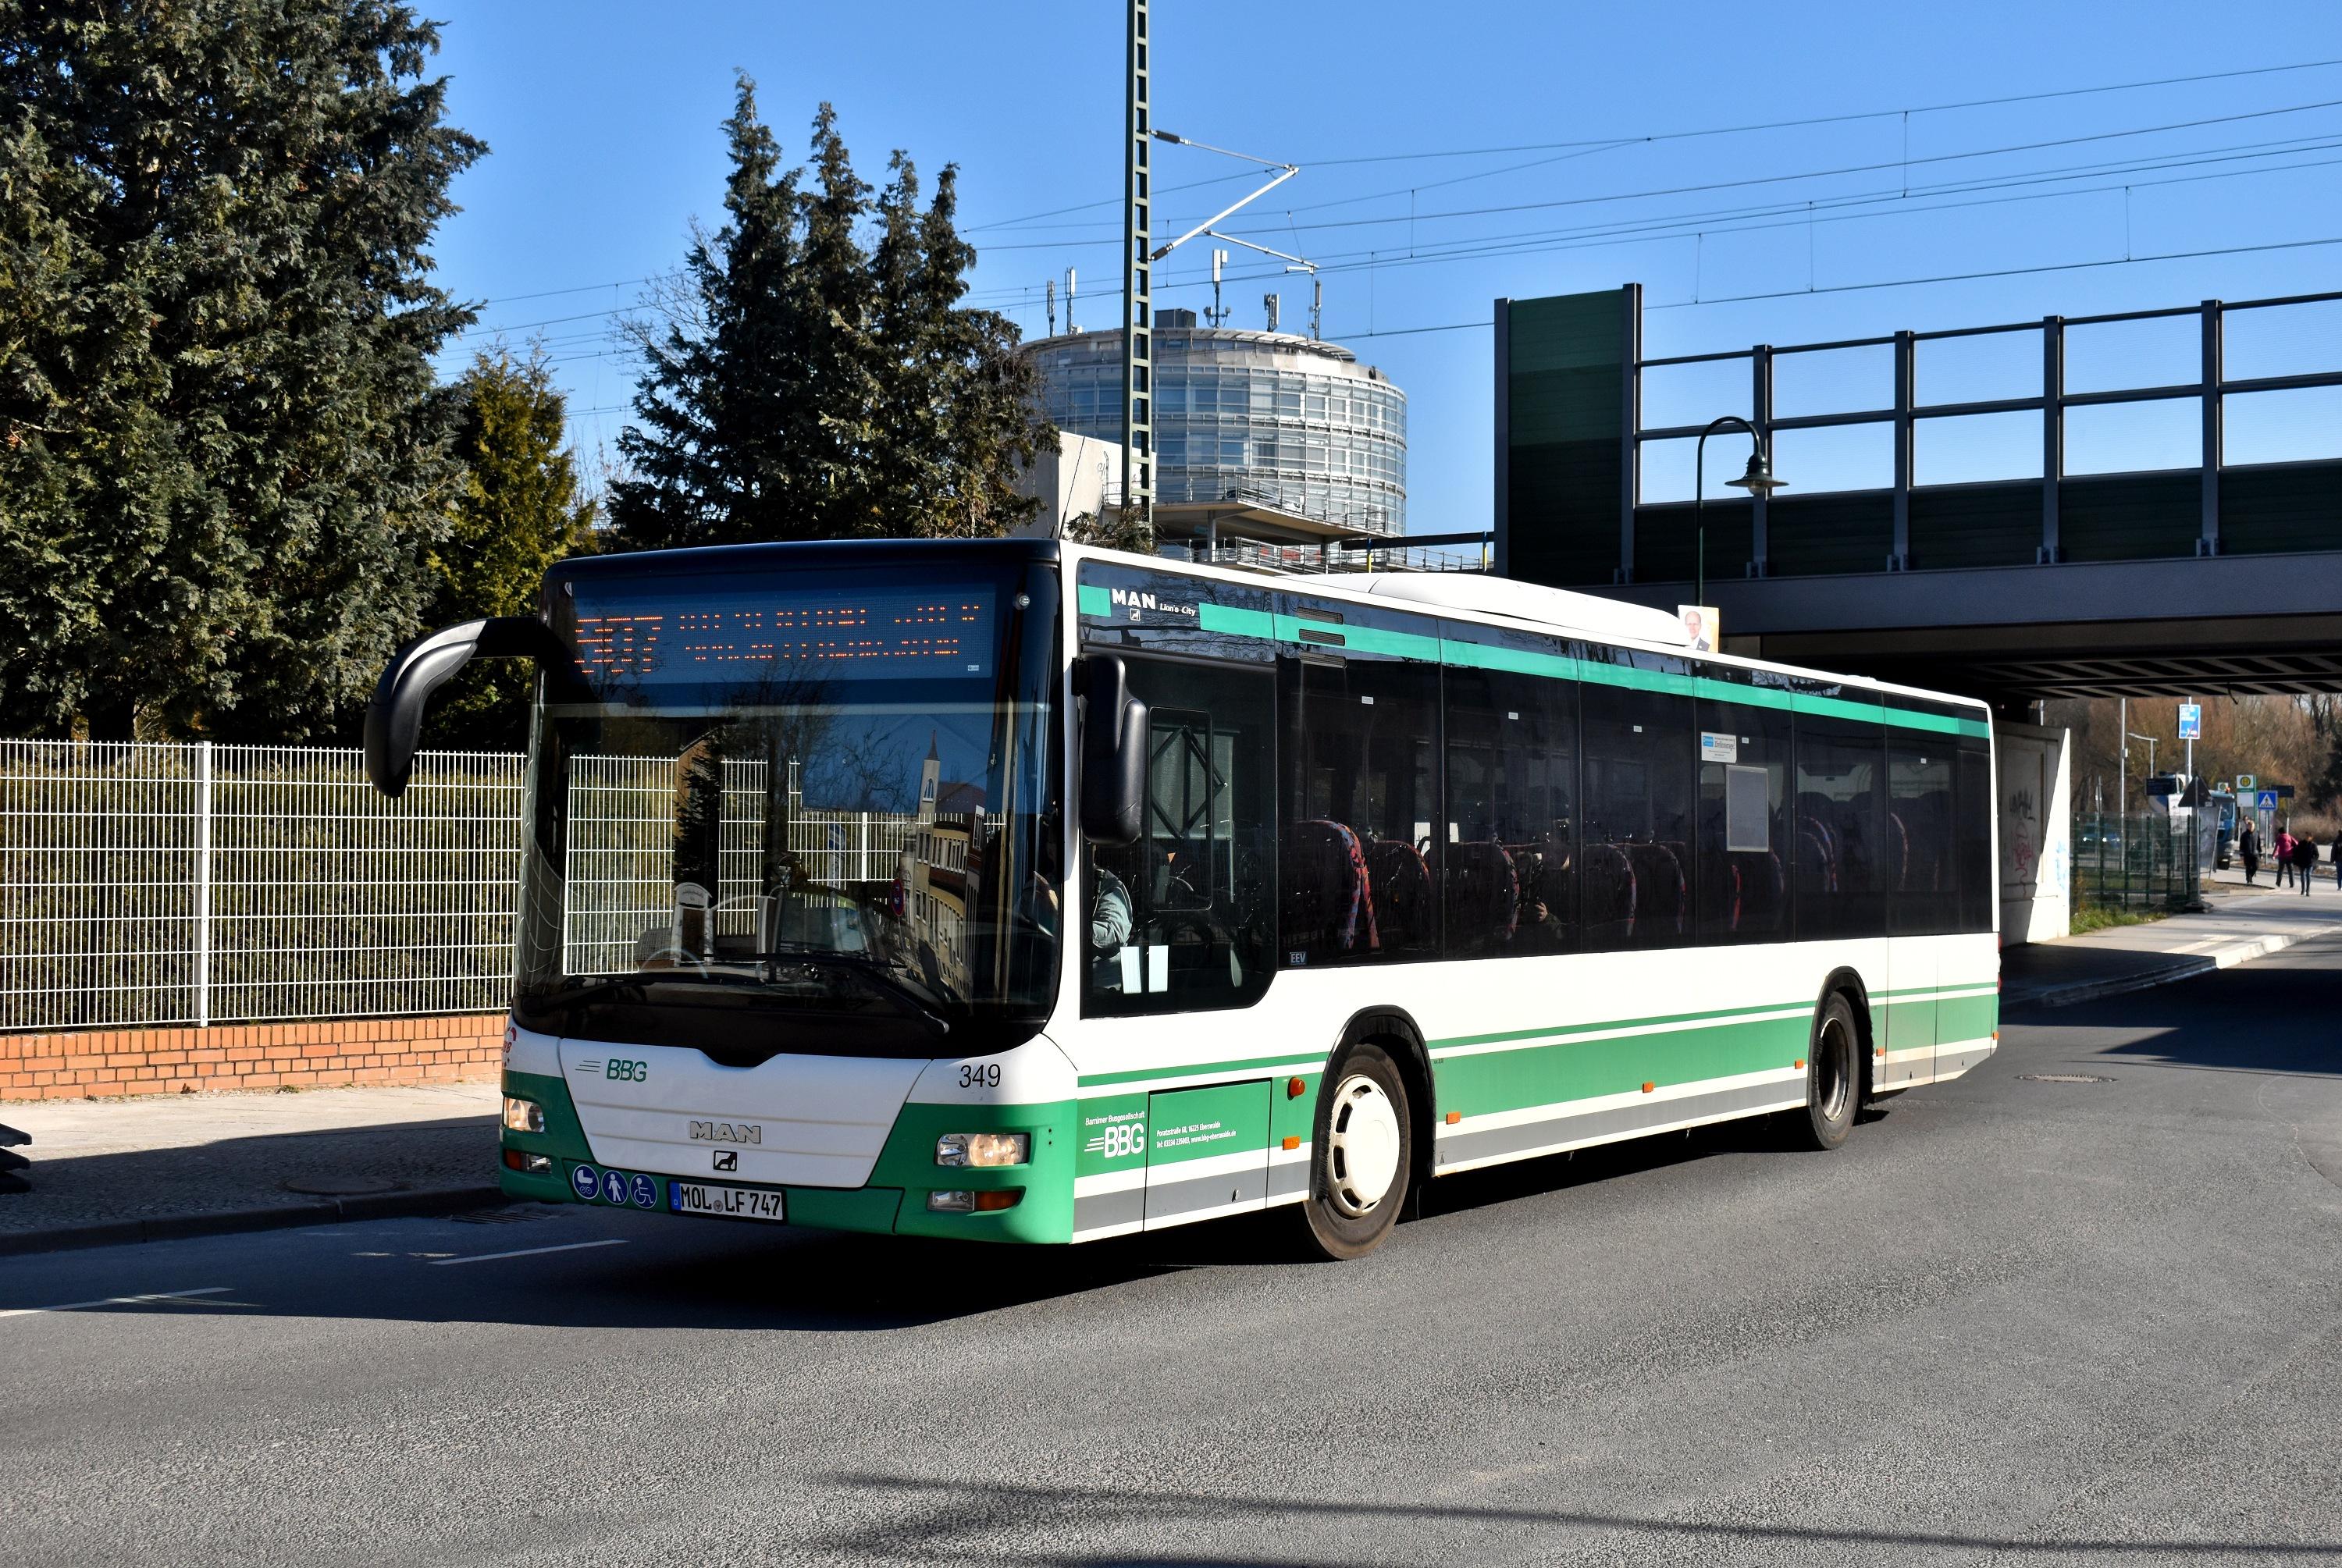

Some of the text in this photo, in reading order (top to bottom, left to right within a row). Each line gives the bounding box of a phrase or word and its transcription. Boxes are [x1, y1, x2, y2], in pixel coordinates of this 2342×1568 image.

[1112, 588, 1197, 617] MAN Lion's City
[1290, 953, 1306, 964] EEV
[607, 1058, 648, 1083] BBG
[959, 1063, 1002, 1089] 349
[1085, 1111, 1145, 1126] Barnimer Busgesellschaft
[1200, 1120, 1221, 1131] Eberswalde
[689, 1120, 762, 1144] MAN
[1104, 1122, 1145, 1159] BBG
[1164, 1139, 1176, 1147] 03334
[1191, 1129, 1237, 1143] www.bbg-eberswalde.de
[680, 1186, 713, 1211] MOL
[724, 1190, 745, 1213] LF
[749, 1192, 781, 1217] 747
